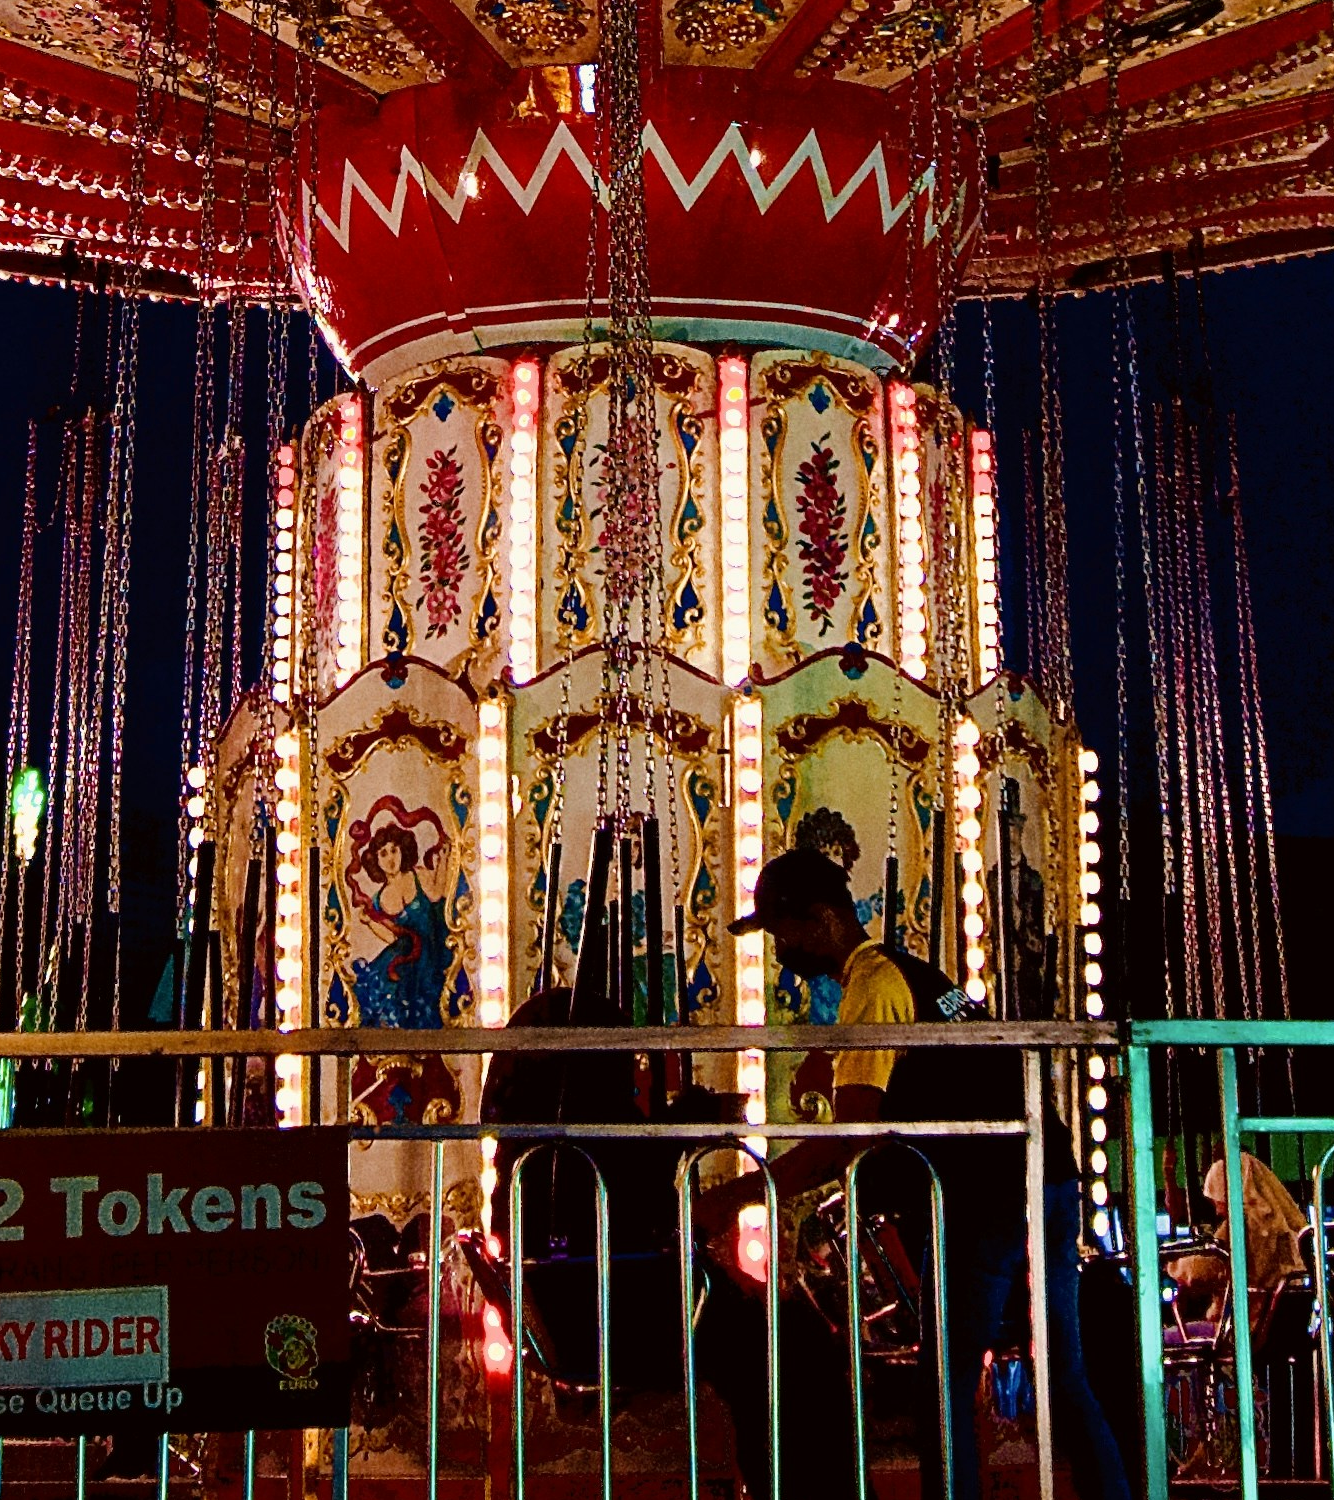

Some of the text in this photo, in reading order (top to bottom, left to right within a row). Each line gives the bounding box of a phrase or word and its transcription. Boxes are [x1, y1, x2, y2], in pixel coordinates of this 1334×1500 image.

[50, 1173, 327, 1239] Tokens
[43, 1315, 161, 1360] RIDER
[35, 1388, 132, 1415] Queue
[142, 1379, 184, 1415] Up
[278, 1379, 319, 1391] EURO
